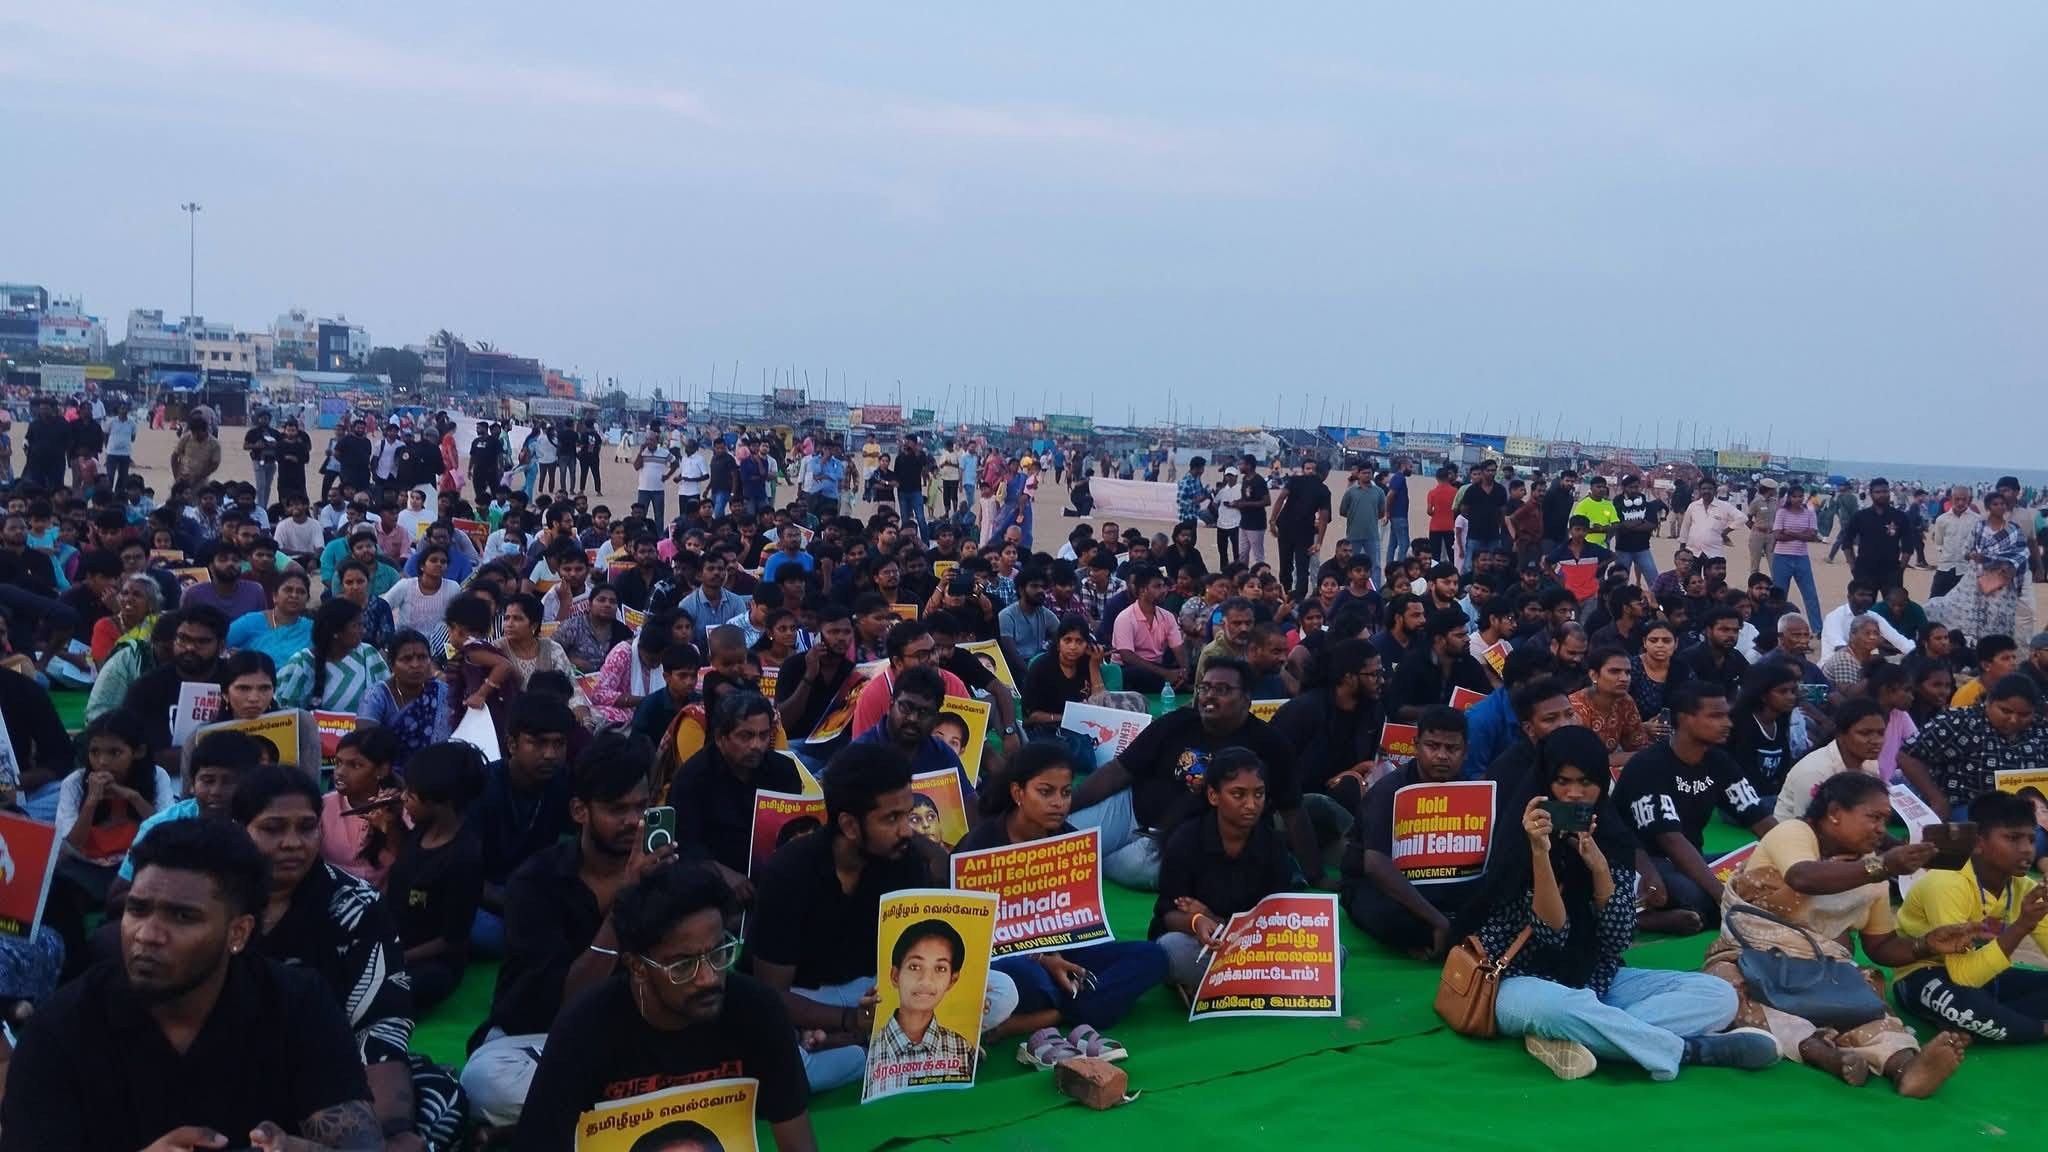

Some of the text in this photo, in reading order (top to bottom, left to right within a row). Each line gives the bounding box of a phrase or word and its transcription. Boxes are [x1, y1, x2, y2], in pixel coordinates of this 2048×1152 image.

[1416, 796, 1449, 815] Hold
[1396, 814, 1487, 838] ferendum for
[964, 836, 1092, 873] An independent
[1392, 832, 1486, 860] amil Eelam.
[957, 851, 1097, 889] Tamil Eelam is the
[1407, 867, 1458, 880] MOVEMENT
[1003, 875, 1067, 897] solution
[1070, 867, 1092, 883] for
[923, 902, 990, 917] வெல்வோம்
[993, 907, 1100, 943] auvinism.
[1255, 911, 1330, 931] ஆண்டுகள்
[1014, 933, 1073, 950] MOVEMENT
[1265, 928, 1319, 948] தமிழீழ
[1270, 995, 1332, 1009] இயக்கம்
[585, 1089, 748, 1137] தமிழீழம் வெல்வோம்
